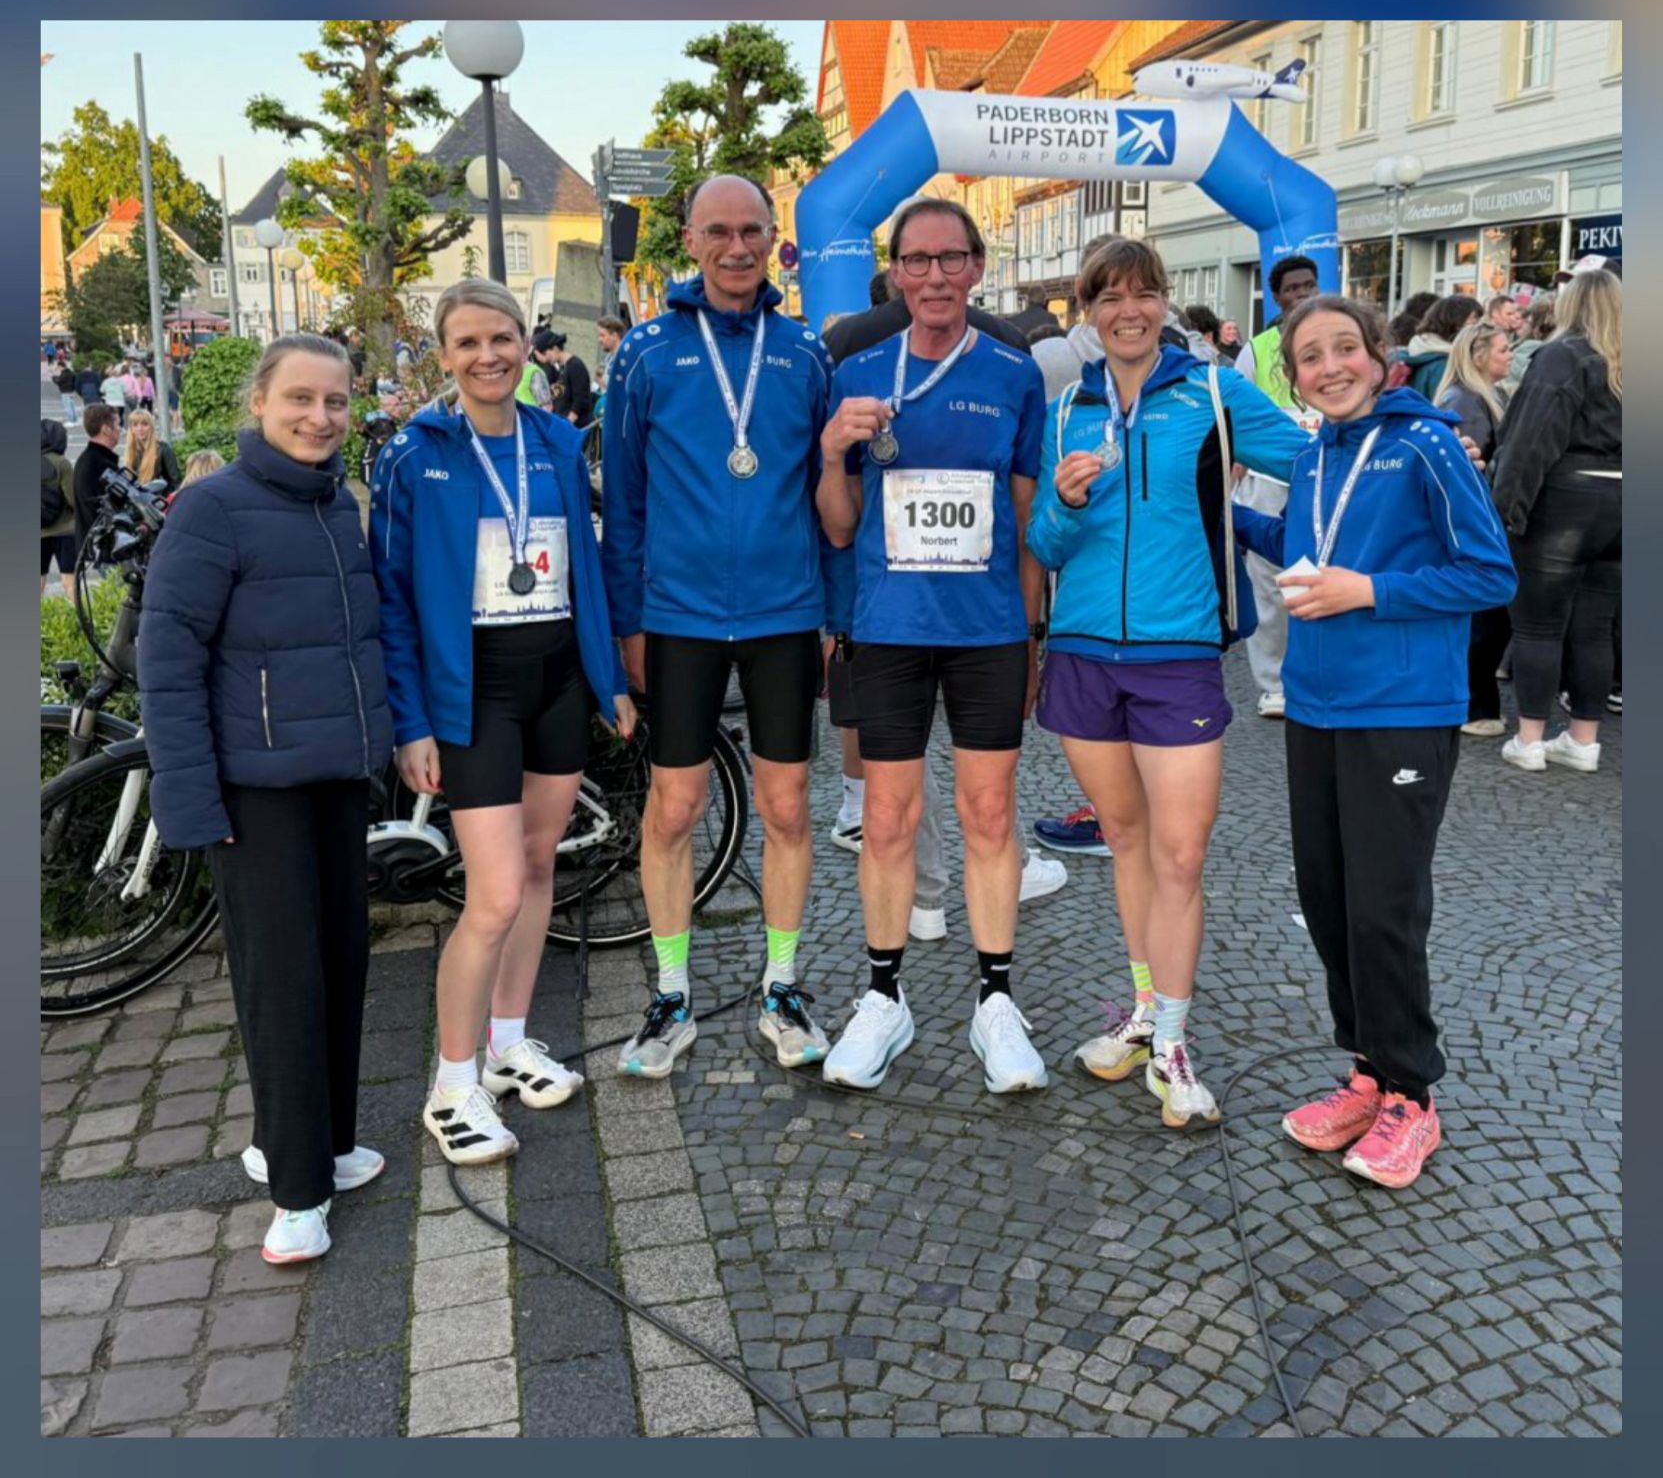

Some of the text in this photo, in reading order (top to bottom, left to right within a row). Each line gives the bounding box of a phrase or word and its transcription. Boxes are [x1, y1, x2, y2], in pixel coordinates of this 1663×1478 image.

[977, 104, 1109, 125] PADERBORN
[989, 126, 1109, 149] LIPPSTADT
[988, 149, 1104, 163] AIRPORT
[676, 355, 700, 366] JAKO
[949, 401, 1000, 418] LG BURG
[1373, 458, 1404, 471] BURG
[423, 469, 450, 480] JAKO
[904, 501, 976, 529] 1300
[920, 536, 959, 546] Norbert
